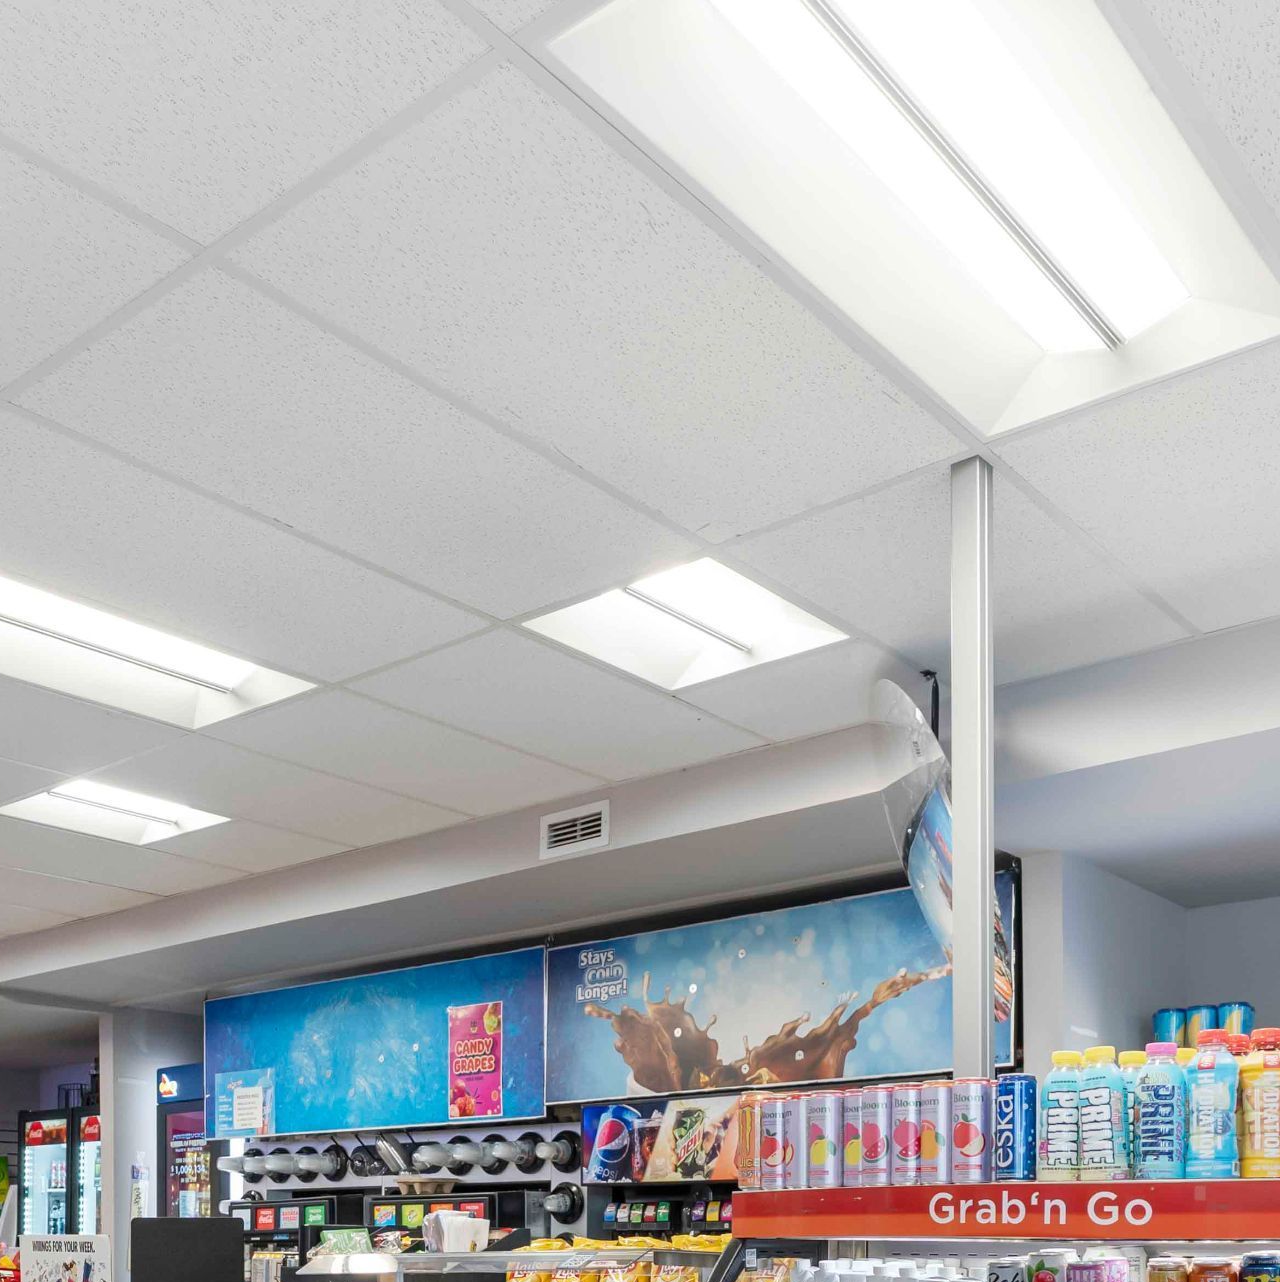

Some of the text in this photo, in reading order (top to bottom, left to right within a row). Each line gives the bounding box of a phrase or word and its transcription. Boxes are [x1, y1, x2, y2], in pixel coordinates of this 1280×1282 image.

[578, 949, 614, 968] Stays
[586, 963, 624, 985] COLD
[576, 981, 628, 1004] Longer!
[454, 1038, 493, 1058] CANDY
[453, 1054, 495, 1075] GRAPES
[953, 1093, 984, 1104] Bloom
[996, 1093, 1014, 1168] eska
[1047, 1090, 1079, 1166] PRIME
[1079, 1087, 1115, 1165] PRIME
[1141, 1084, 1175, 1162] PRIME
[1087, 1191, 1154, 1226] Go
[53, 1241, 62, 1252] FOR
[64, 1241, 78, 1252] YOUR
[80, 1241, 96, 1253] WEEK.
